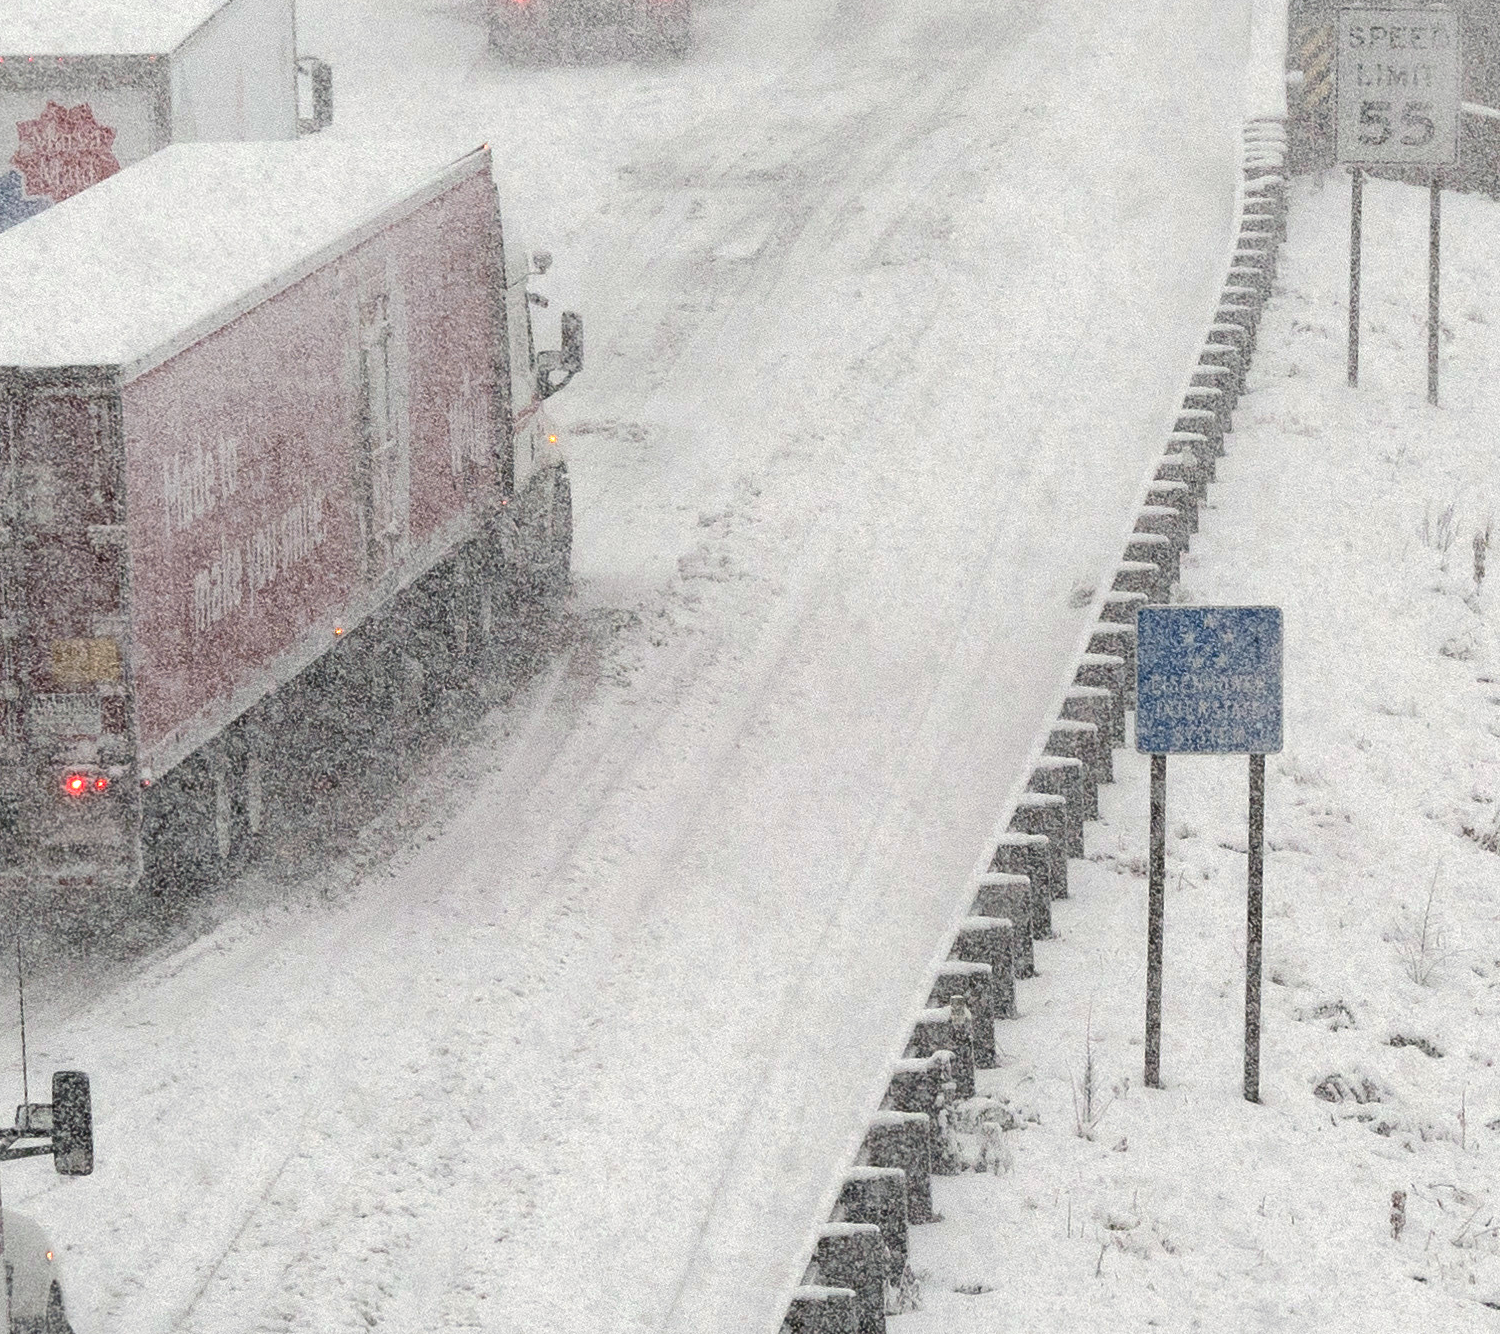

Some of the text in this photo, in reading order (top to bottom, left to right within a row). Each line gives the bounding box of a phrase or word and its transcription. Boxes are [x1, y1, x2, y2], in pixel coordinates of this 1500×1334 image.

[1348, 24, 1451, 50] SPEED
[1355, 62, 1437, 88] LIMIT
[1357, 100, 1436, 148] 55
